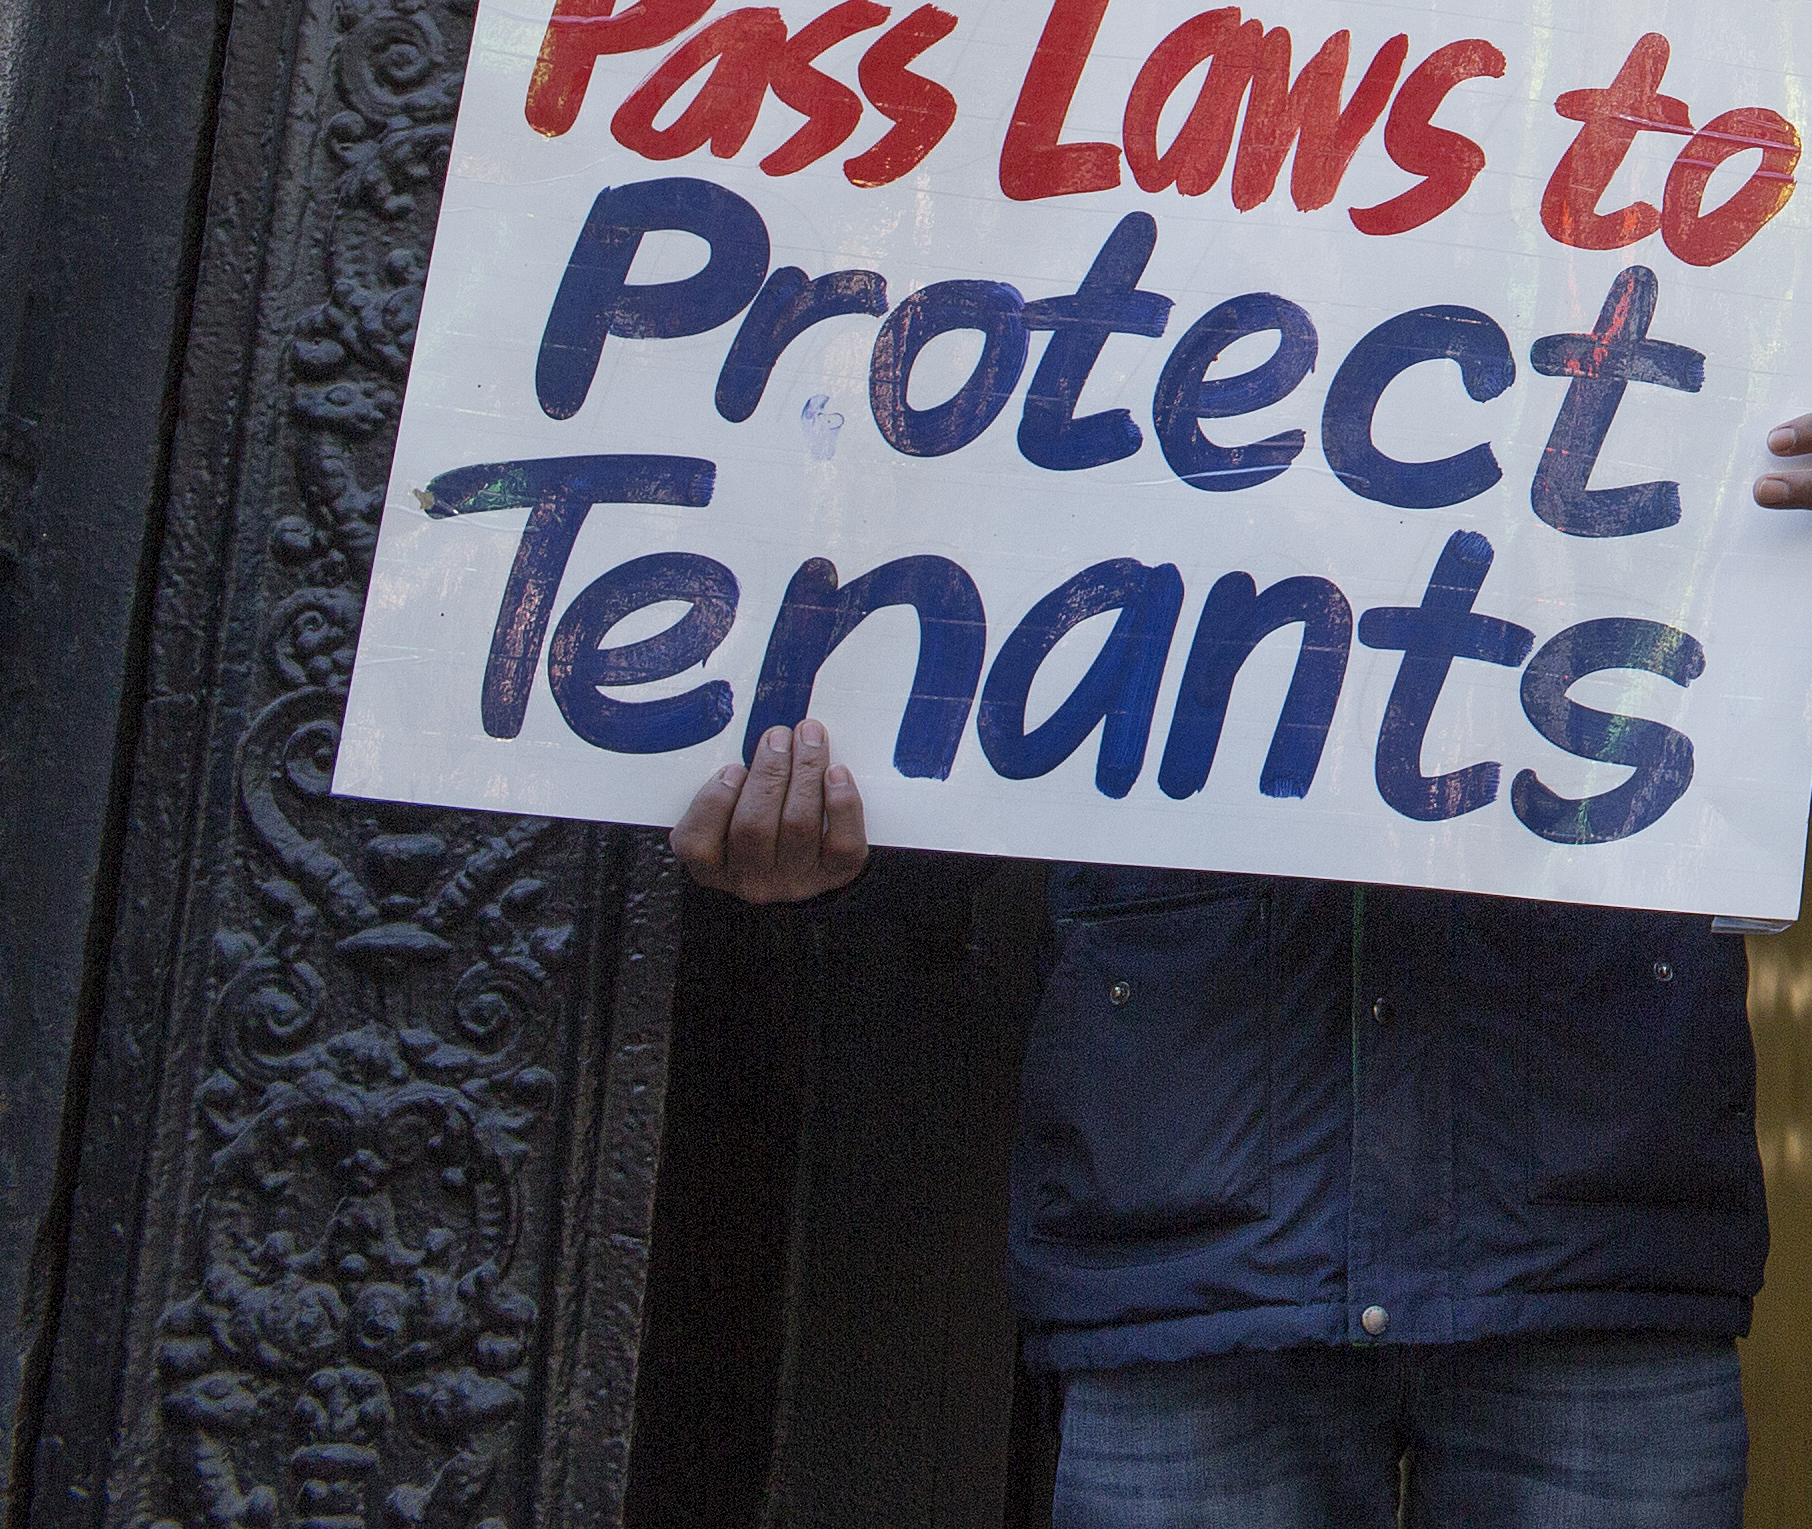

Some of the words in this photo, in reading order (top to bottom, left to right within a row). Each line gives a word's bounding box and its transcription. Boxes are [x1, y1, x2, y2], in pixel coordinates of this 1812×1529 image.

[1539, 31, 1803, 267] to
[534, 176, 1706, 539] Protect
[413, 454, 1706, 846] Tenants
